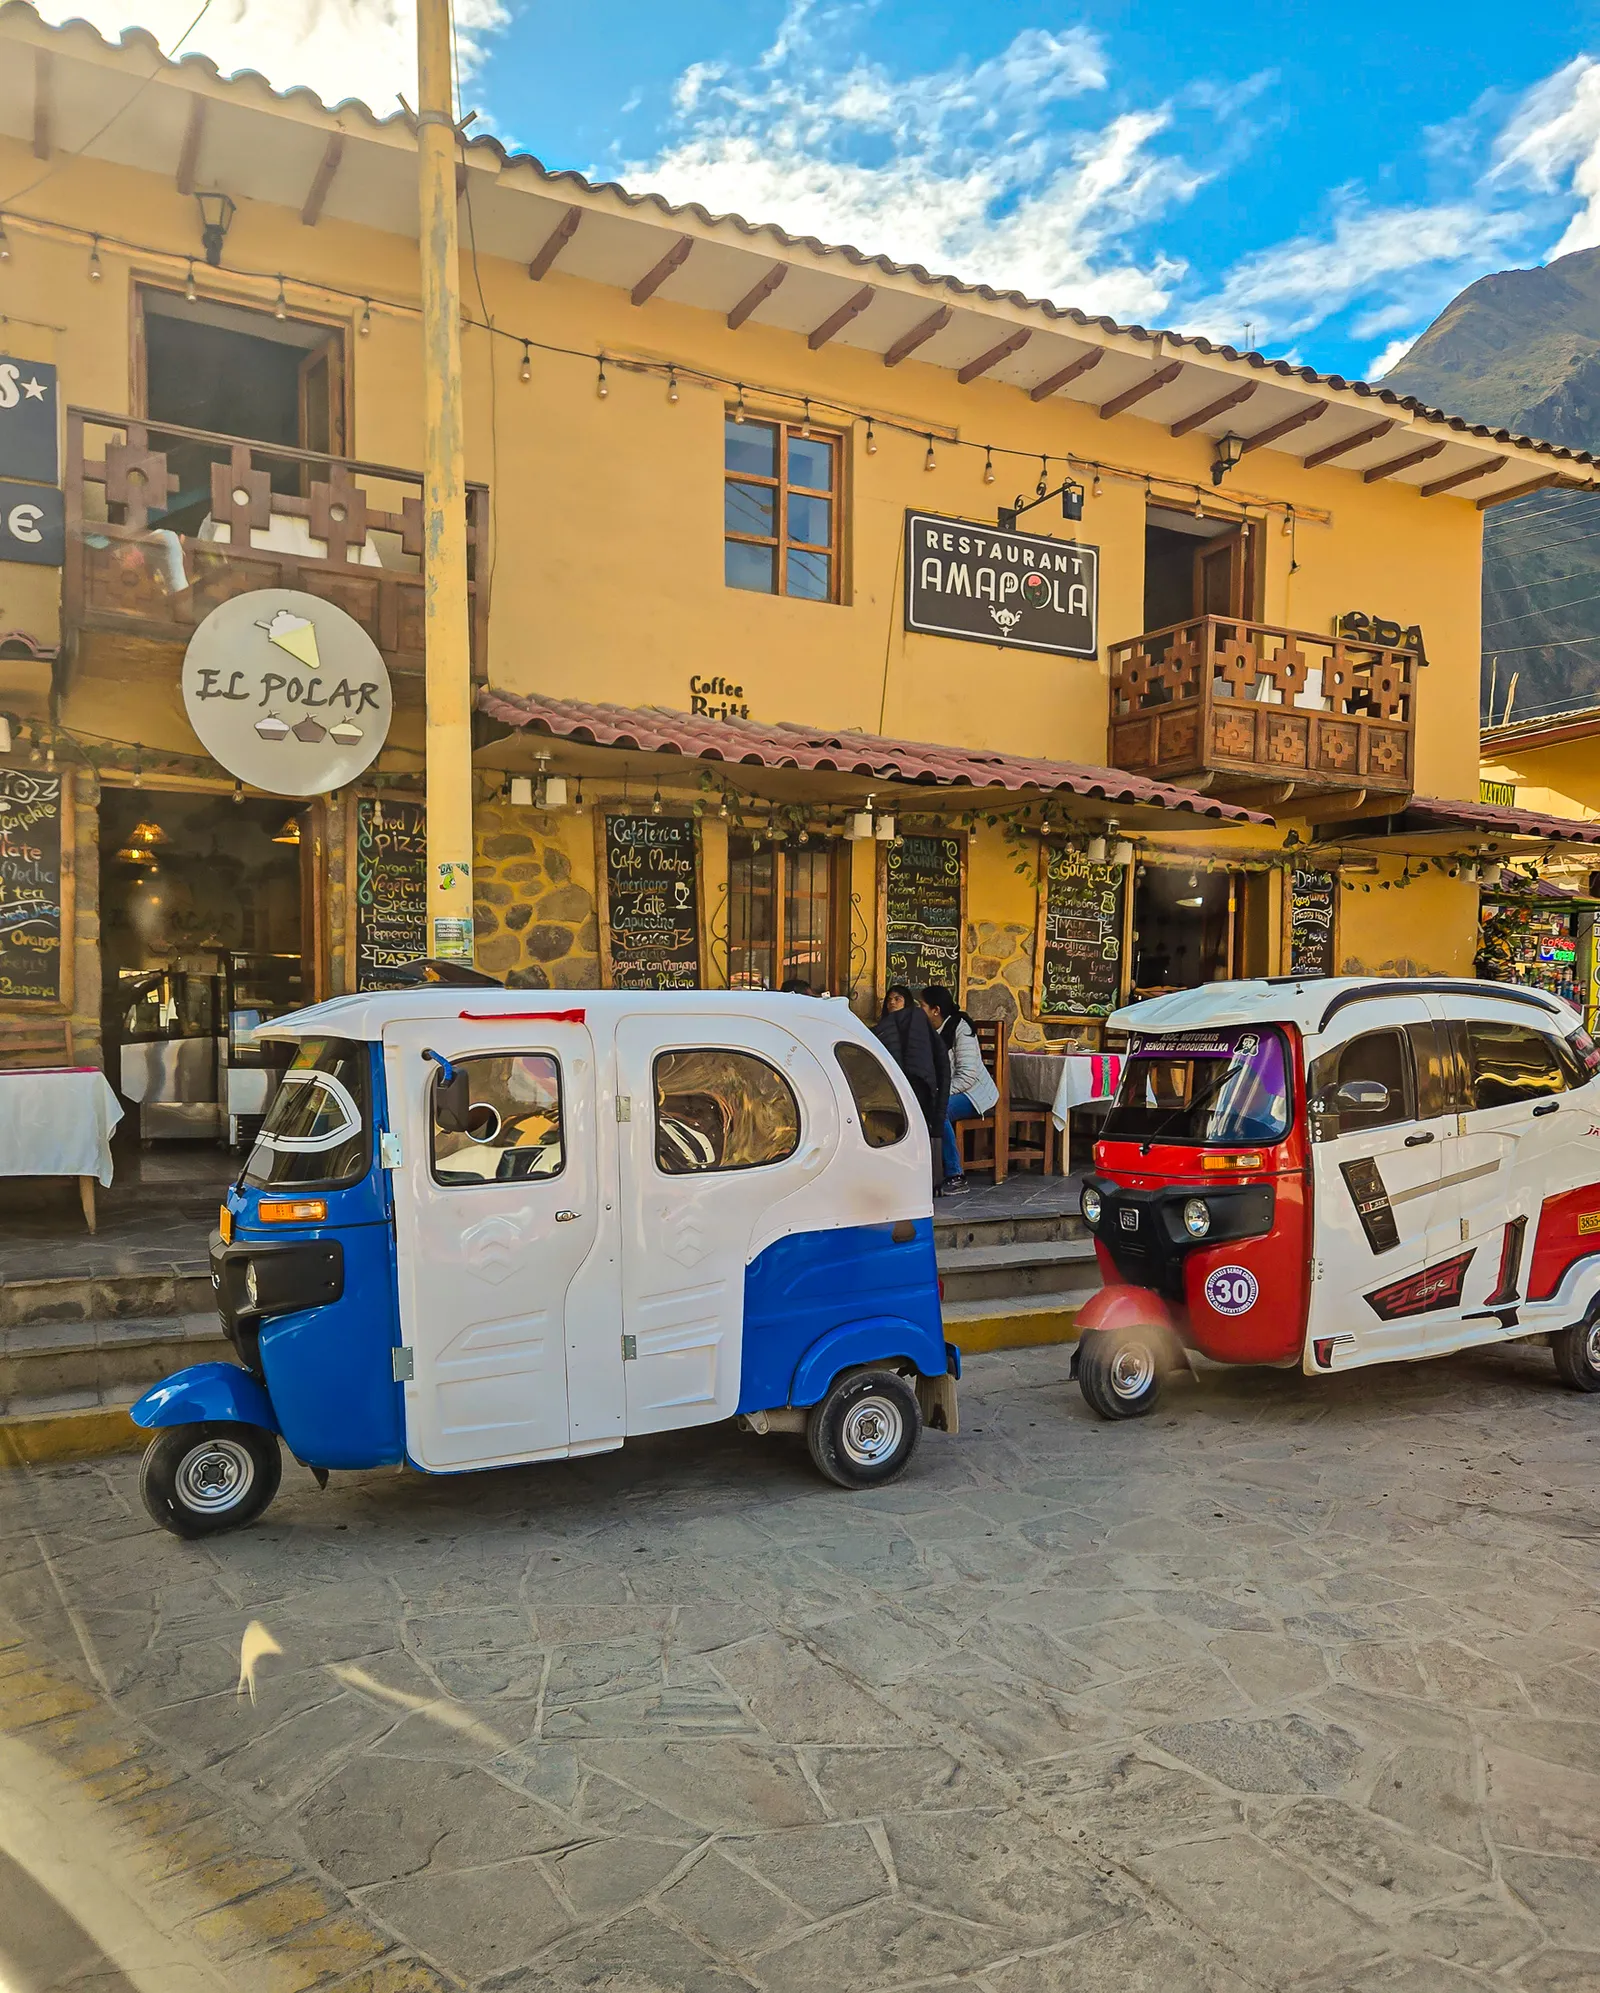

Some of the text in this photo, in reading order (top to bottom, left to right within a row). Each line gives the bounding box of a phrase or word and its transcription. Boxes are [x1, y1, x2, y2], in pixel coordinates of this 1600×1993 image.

[926, 529, 1083, 575] RESTAURANT
[921, 557, 1088, 617] AMAPOLA
[195, 668, 380, 715] EL POLAR
[690, 675, 743, 698] Coffee
[613, 819, 681, 846] Cafeteria
[364, 856, 427, 877] Margarit
[649, 848, 692, 872] Mocha
[1541, 936, 1576, 950] Coffee
[378, 951, 425, 964] PAST
[1165, 1043, 1176, 1051] DE
[1180, 1033, 1219, 1041] MOTOTAXIS
[1216, 1279, 1249, 1304] 30
